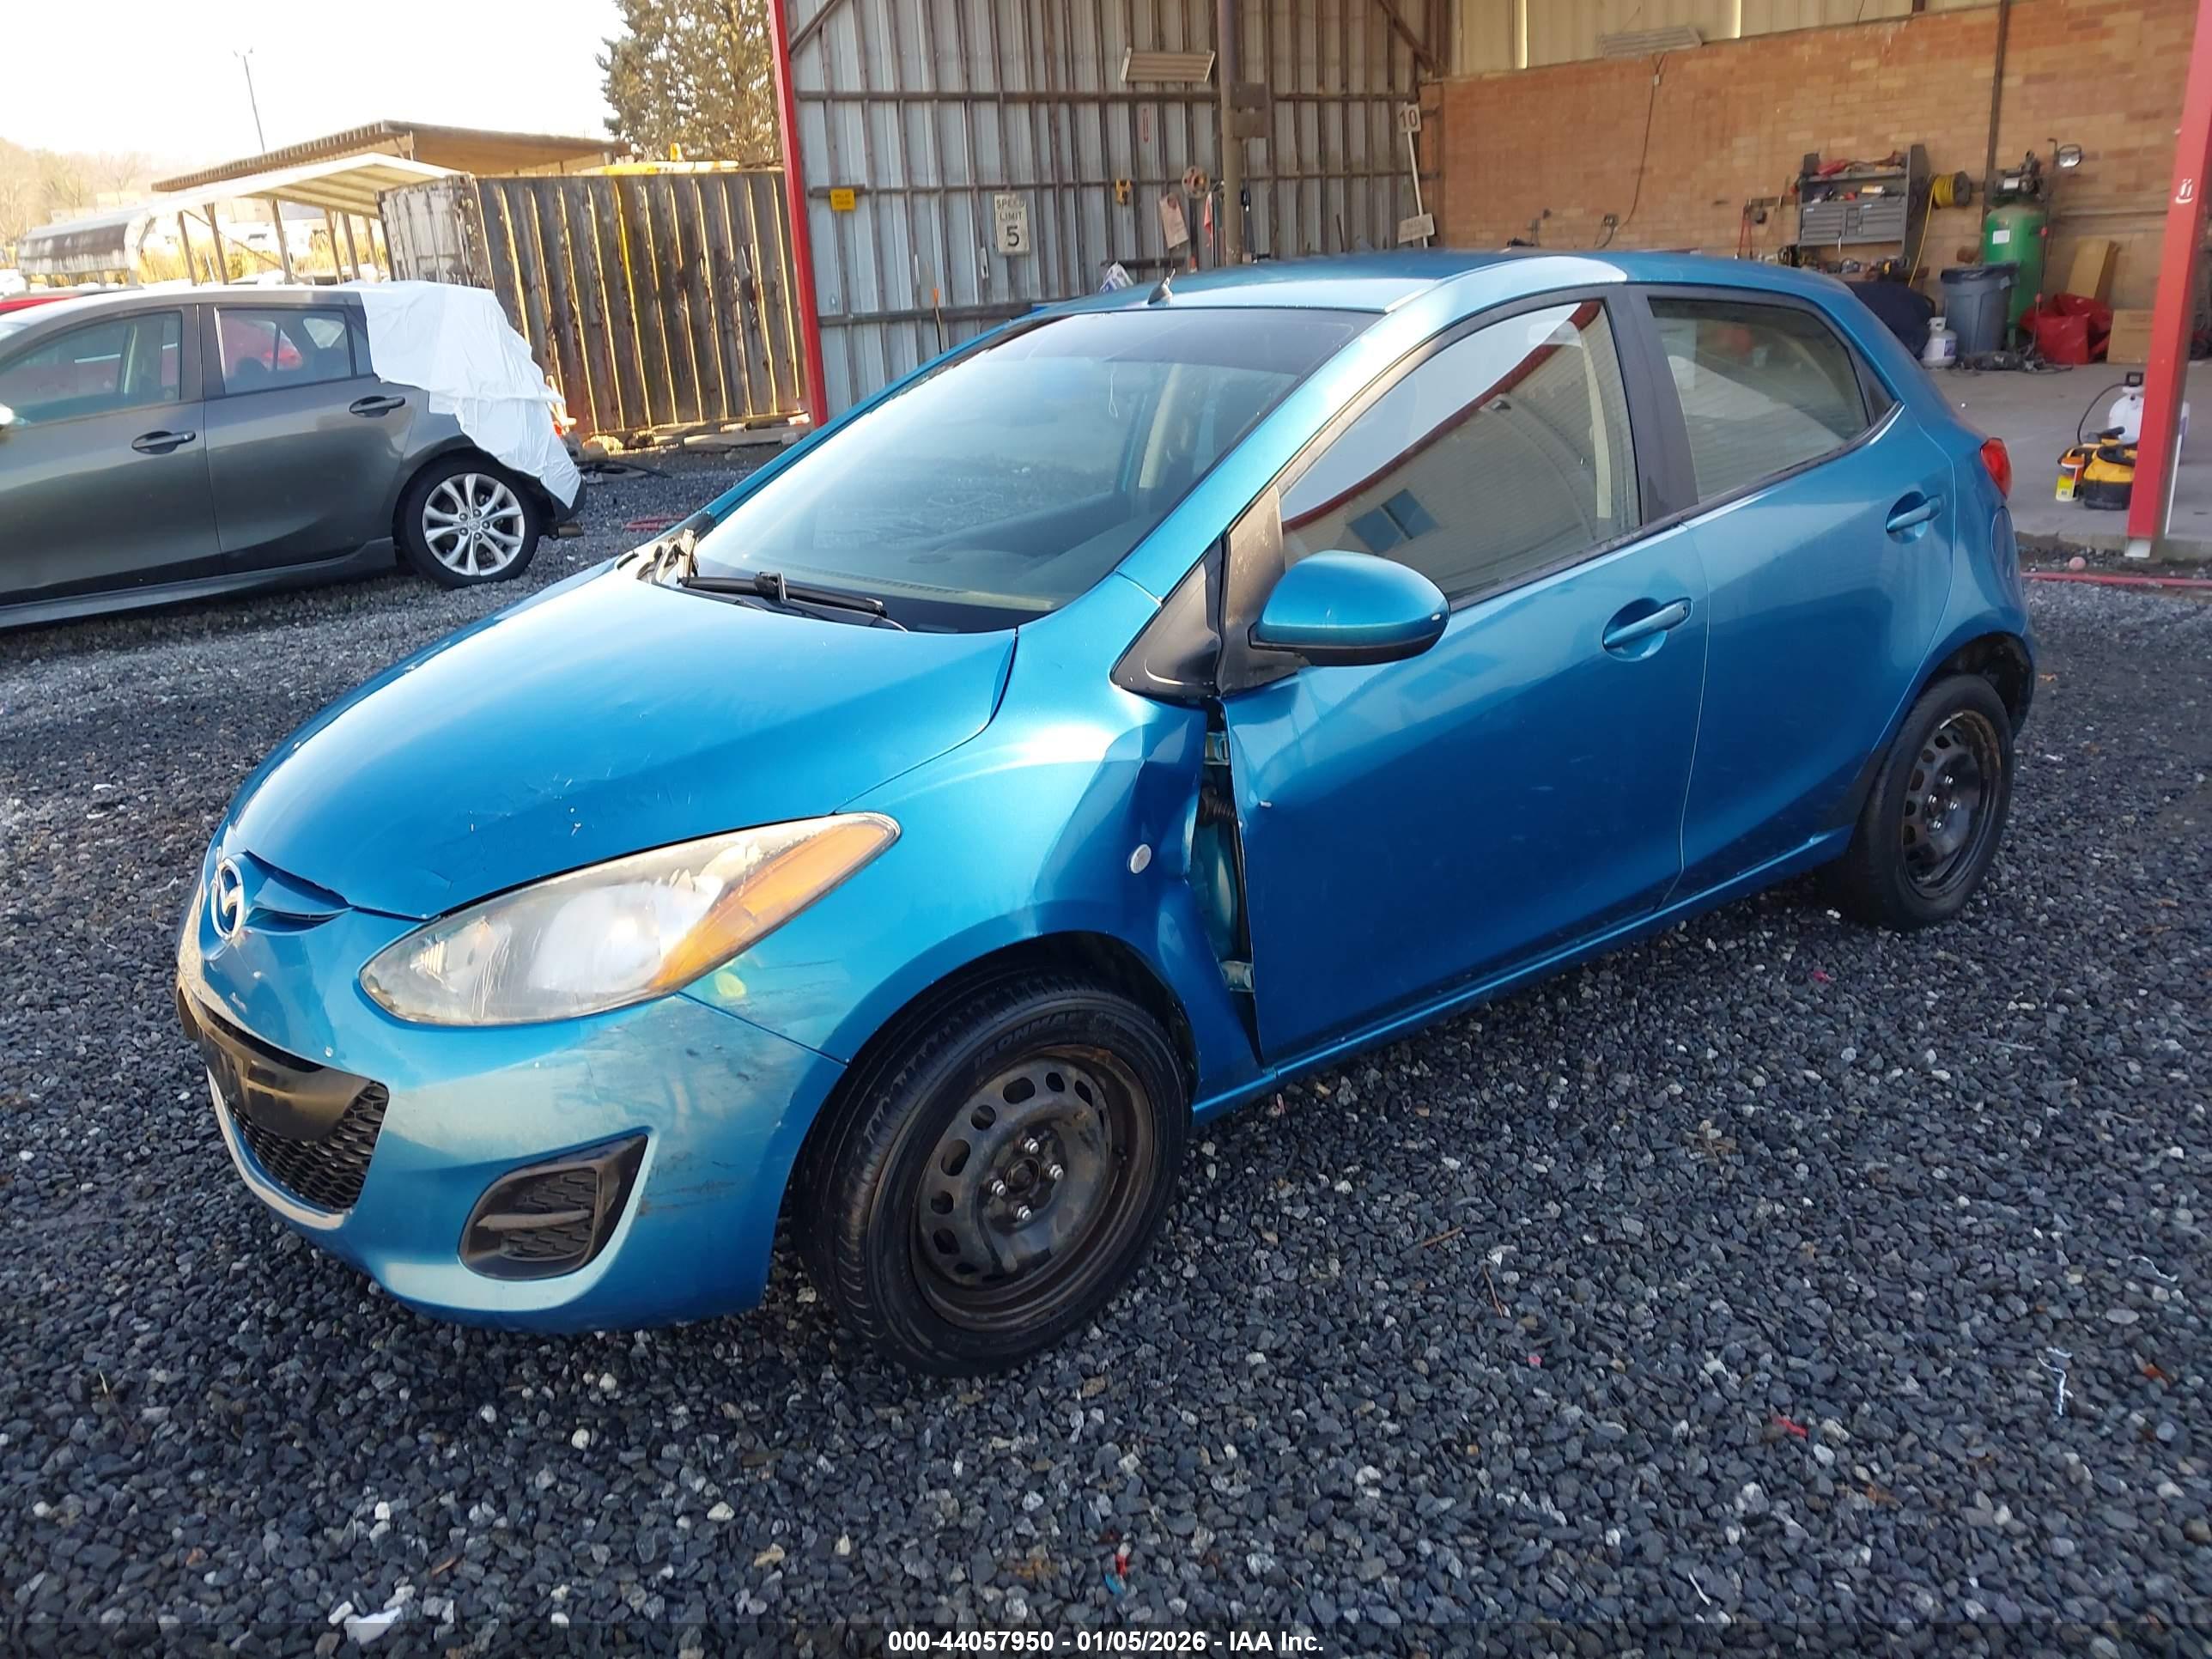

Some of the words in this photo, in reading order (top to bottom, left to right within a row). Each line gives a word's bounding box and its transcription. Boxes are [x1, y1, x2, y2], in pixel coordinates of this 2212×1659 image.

[1400, 109, 1418, 128] 10
[1000, 211, 1022, 221] LIMIT
[1006, 225, 1020, 247] 5
